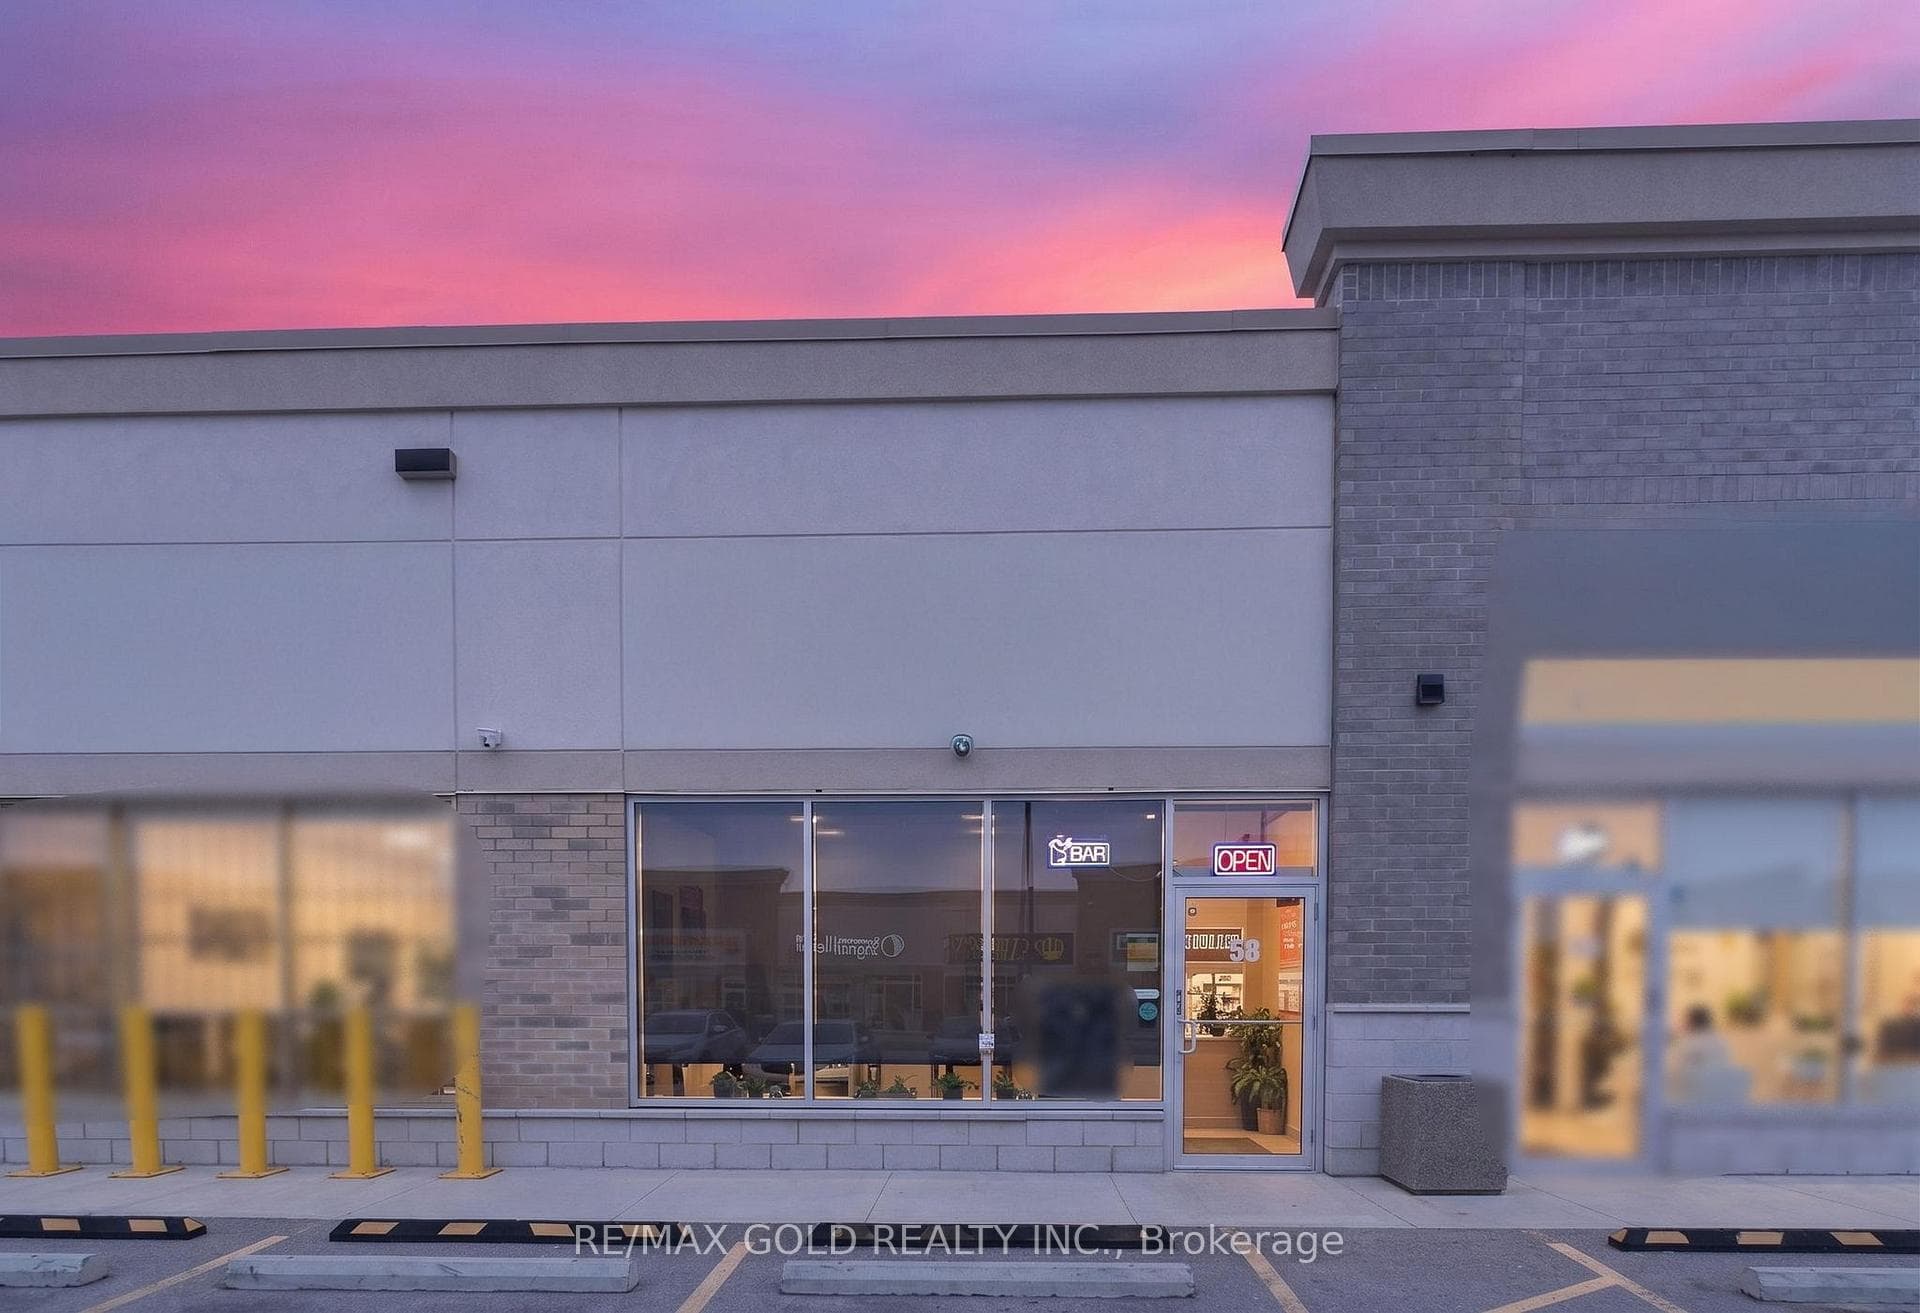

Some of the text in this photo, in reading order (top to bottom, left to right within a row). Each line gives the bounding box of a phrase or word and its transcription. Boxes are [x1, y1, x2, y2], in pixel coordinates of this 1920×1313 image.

[1070, 846, 1106, 862] BAR
[1218, 850, 1272, 871] OPEN
[1229, 939, 1260, 962] 58
